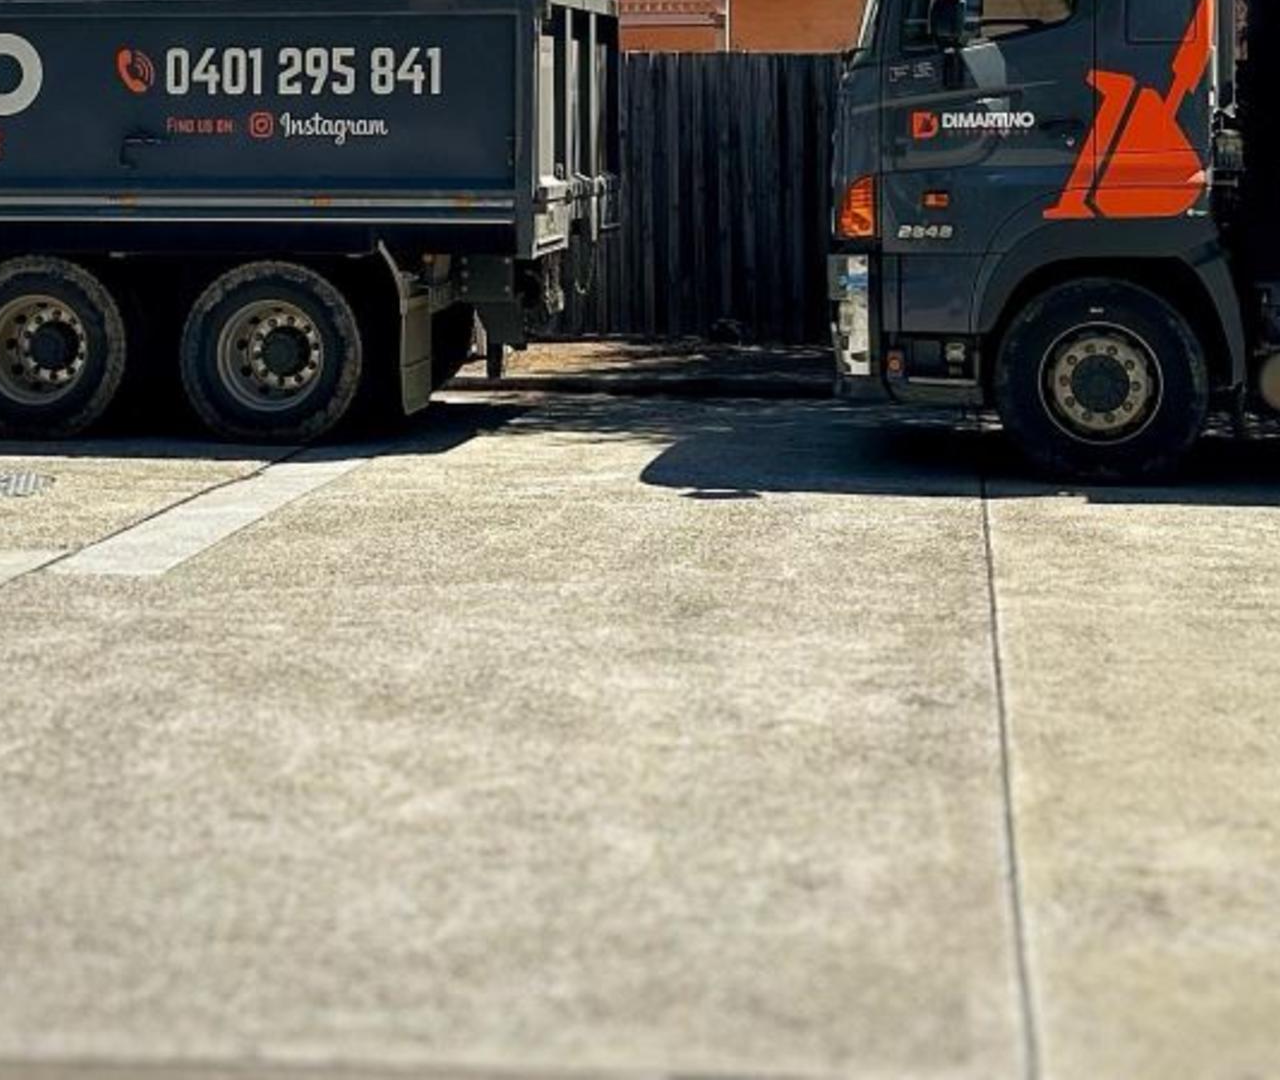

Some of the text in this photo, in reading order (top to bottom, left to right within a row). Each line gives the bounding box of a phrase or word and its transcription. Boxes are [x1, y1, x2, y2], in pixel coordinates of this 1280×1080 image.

[166, 47, 442, 95] 0401 295 841
[280, 112, 389, 145] Instagram
[941, 111, 1035, 128] DIMARTINO
